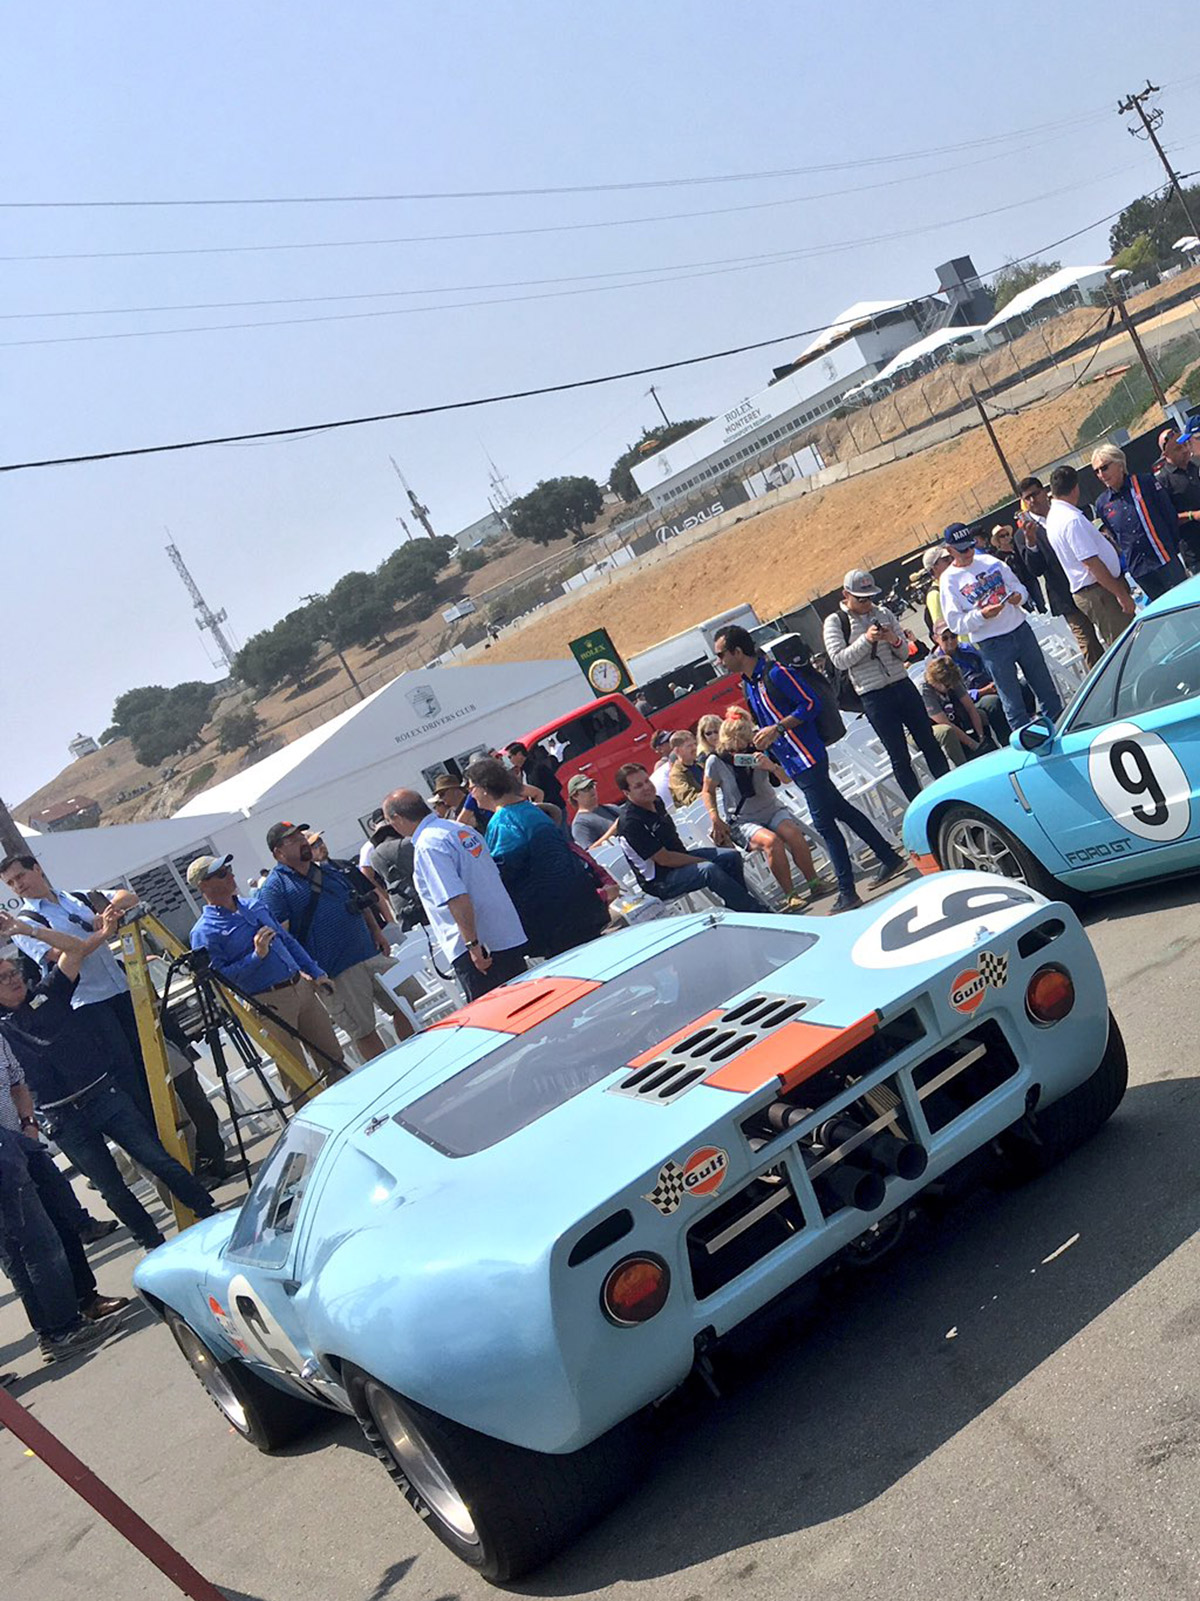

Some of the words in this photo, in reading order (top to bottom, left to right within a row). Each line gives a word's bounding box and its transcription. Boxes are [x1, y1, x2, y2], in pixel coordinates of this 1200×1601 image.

[724, 401, 753, 422] ROLEX
[724, 407, 762, 435] MONTEREY
[673, 501, 725, 535] LEXUS
[580, 644, 606, 660] ROLEX
[395, 727, 422, 743] ROLEX
[421, 713, 456, 733] DRIVERS
[455, 703, 477, 718] CLUB
[1109, 740, 1169, 826] 9
[1065, 844, 1111, 864] FORD
[1108, 837, 1132, 851] GT
[880, 885, 1035, 952] 6
[951, 976, 987, 1005] Gulf
[684, 1154, 724, 1187] Gulf
